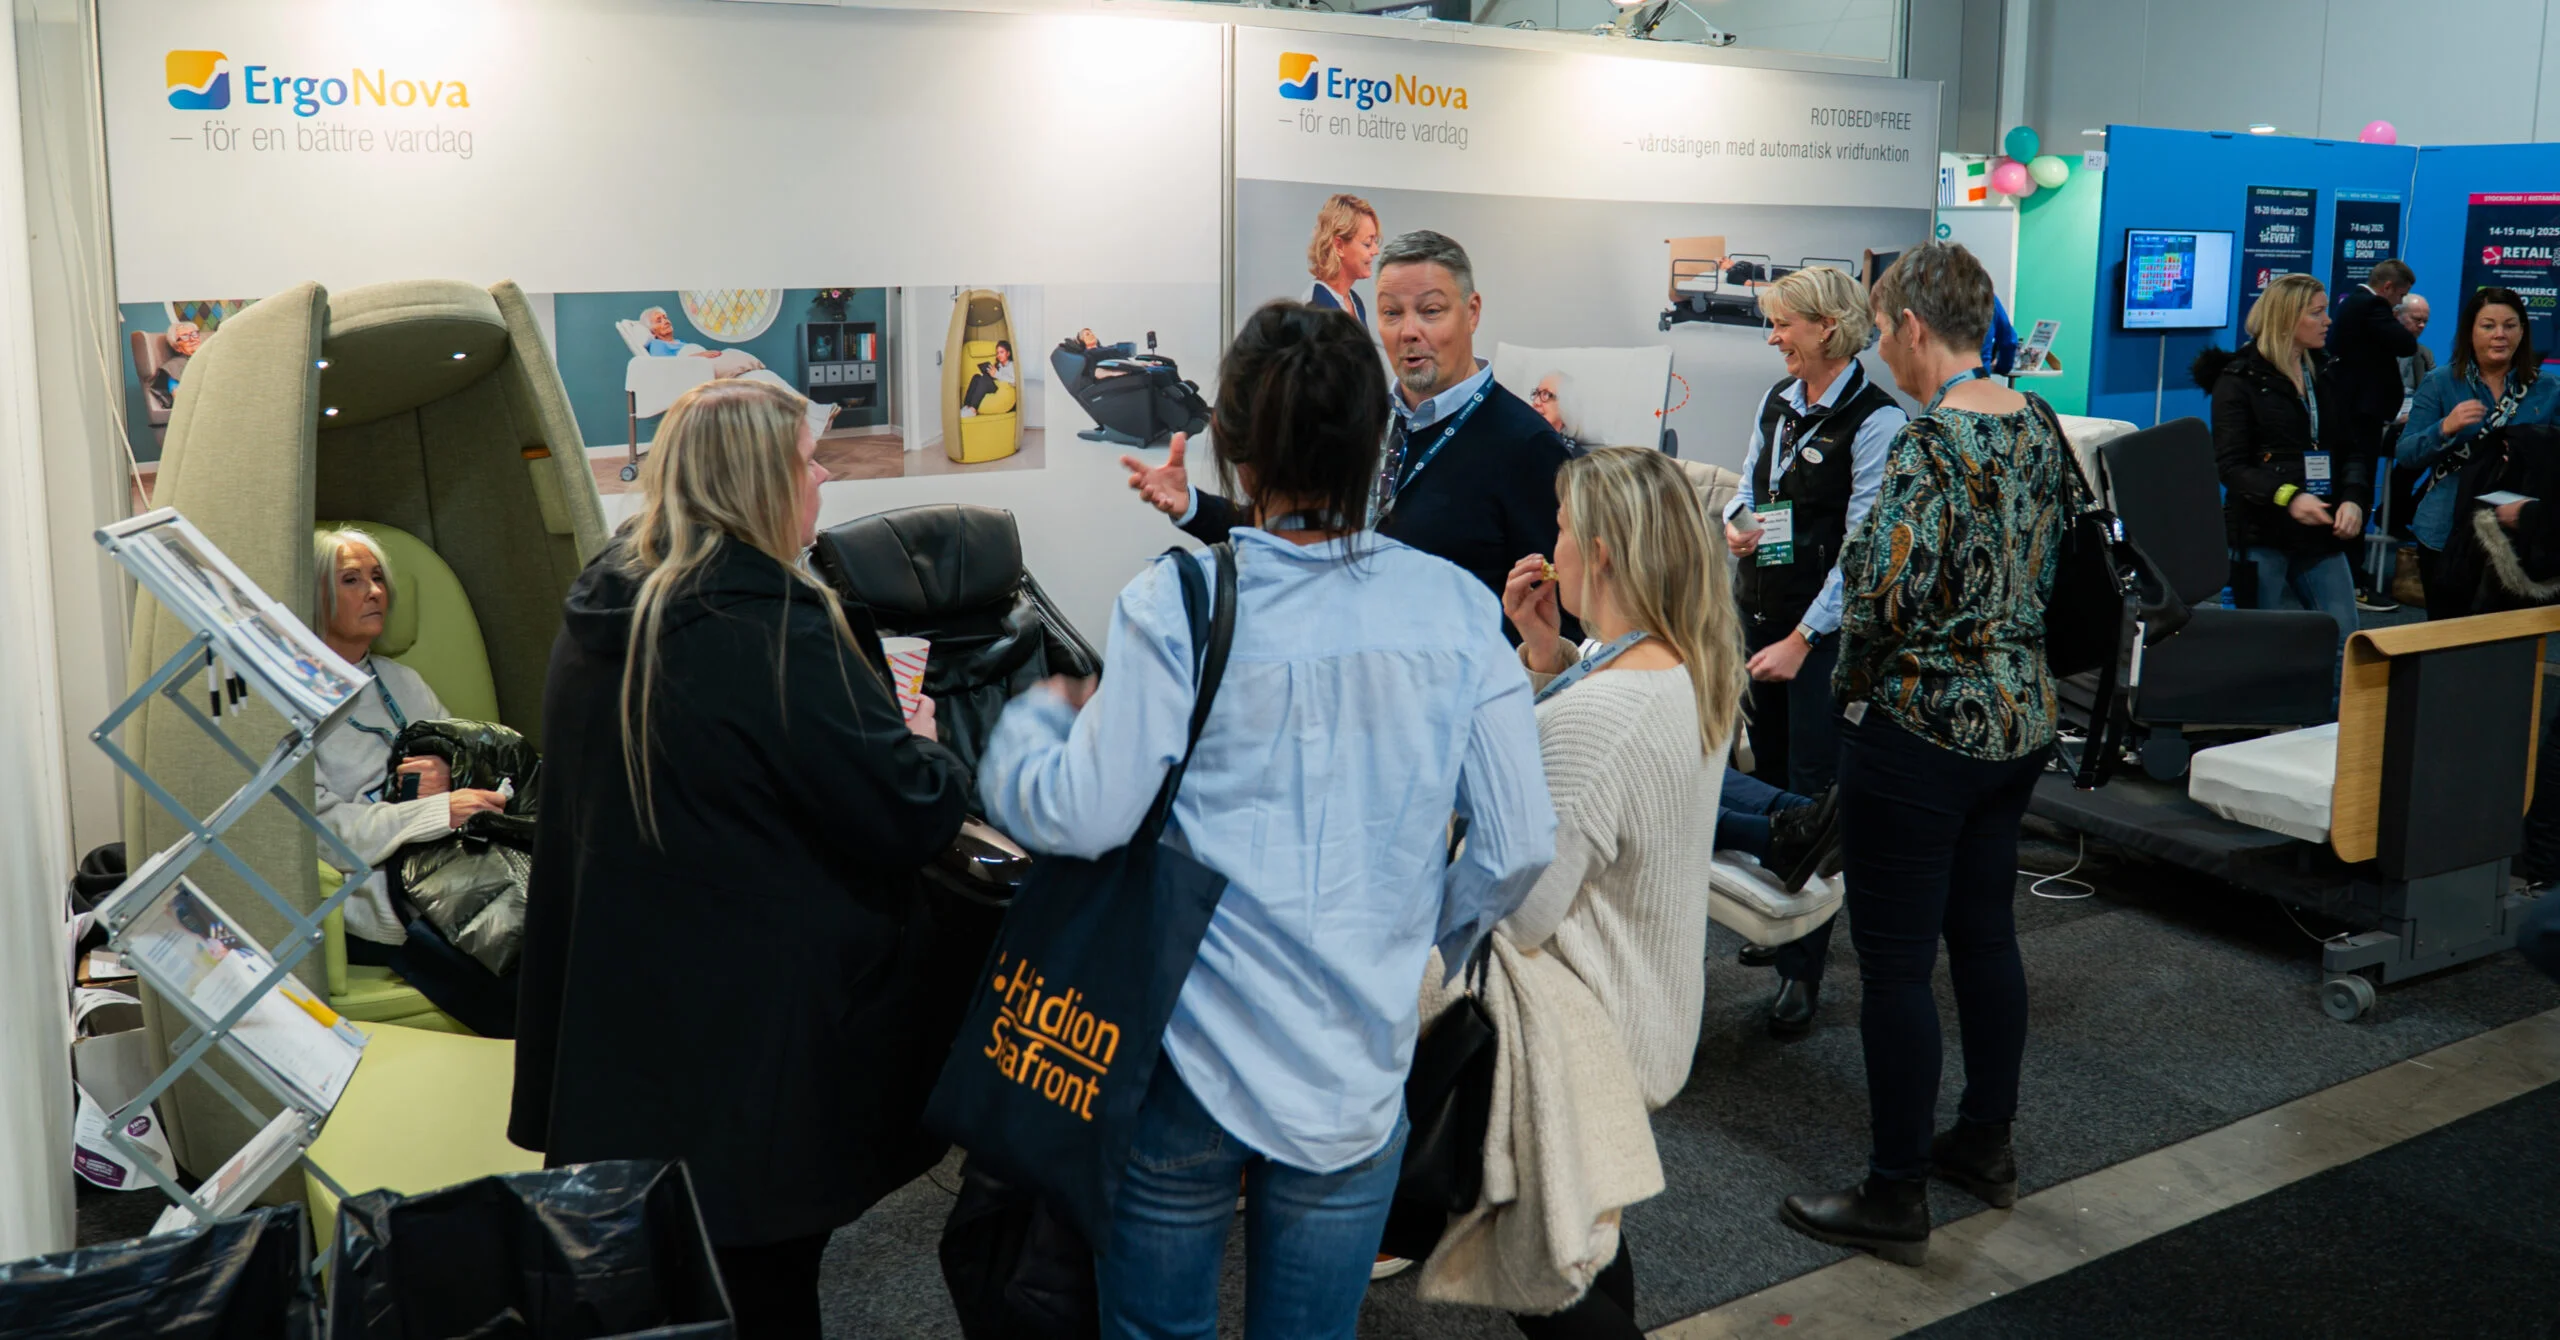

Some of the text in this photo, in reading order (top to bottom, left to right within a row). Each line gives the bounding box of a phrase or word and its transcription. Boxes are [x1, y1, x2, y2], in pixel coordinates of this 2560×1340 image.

[244, 65, 470, 117] ErgoNova
[1327, 67, 1469, 111] ErgoNova
[1299, 107, 1323, 133] för
[1329, 115, 1351, 136] en
[1357, 113, 1407, 141] bättre
[1412, 121, 1468, 150] vardag
[202, 120, 241, 152] för
[252, 127, 285, 152] en
[297, 121, 374, 152] bättre
[384, 124, 473, 160] vardag
[1638, 132, 1721, 158] vårdsängen
[1726, 139, 1756, 156] med
[1760, 141, 1833, 159] automatisk
[1836, 142, 1910, 163] vridfunktion
[2270, 205, 2294, 216] februari
[2294, 207, 2309, 216] 2025
[2360, 224, 2371, 234] maj
[2370, 223, 2384, 232] 2025
[2489, 226, 2560, 238] 14-15 maj 2025
[2270, 232, 2295, 244] EVENT
[2355, 239, 2373, 250] OSLO
[2374, 240, 2390, 250] TECH
[2355, 249, 2375, 259] SHOW
[2502, 246, 2553, 259] RETAIL
[2529, 296, 2557, 308] 2025
